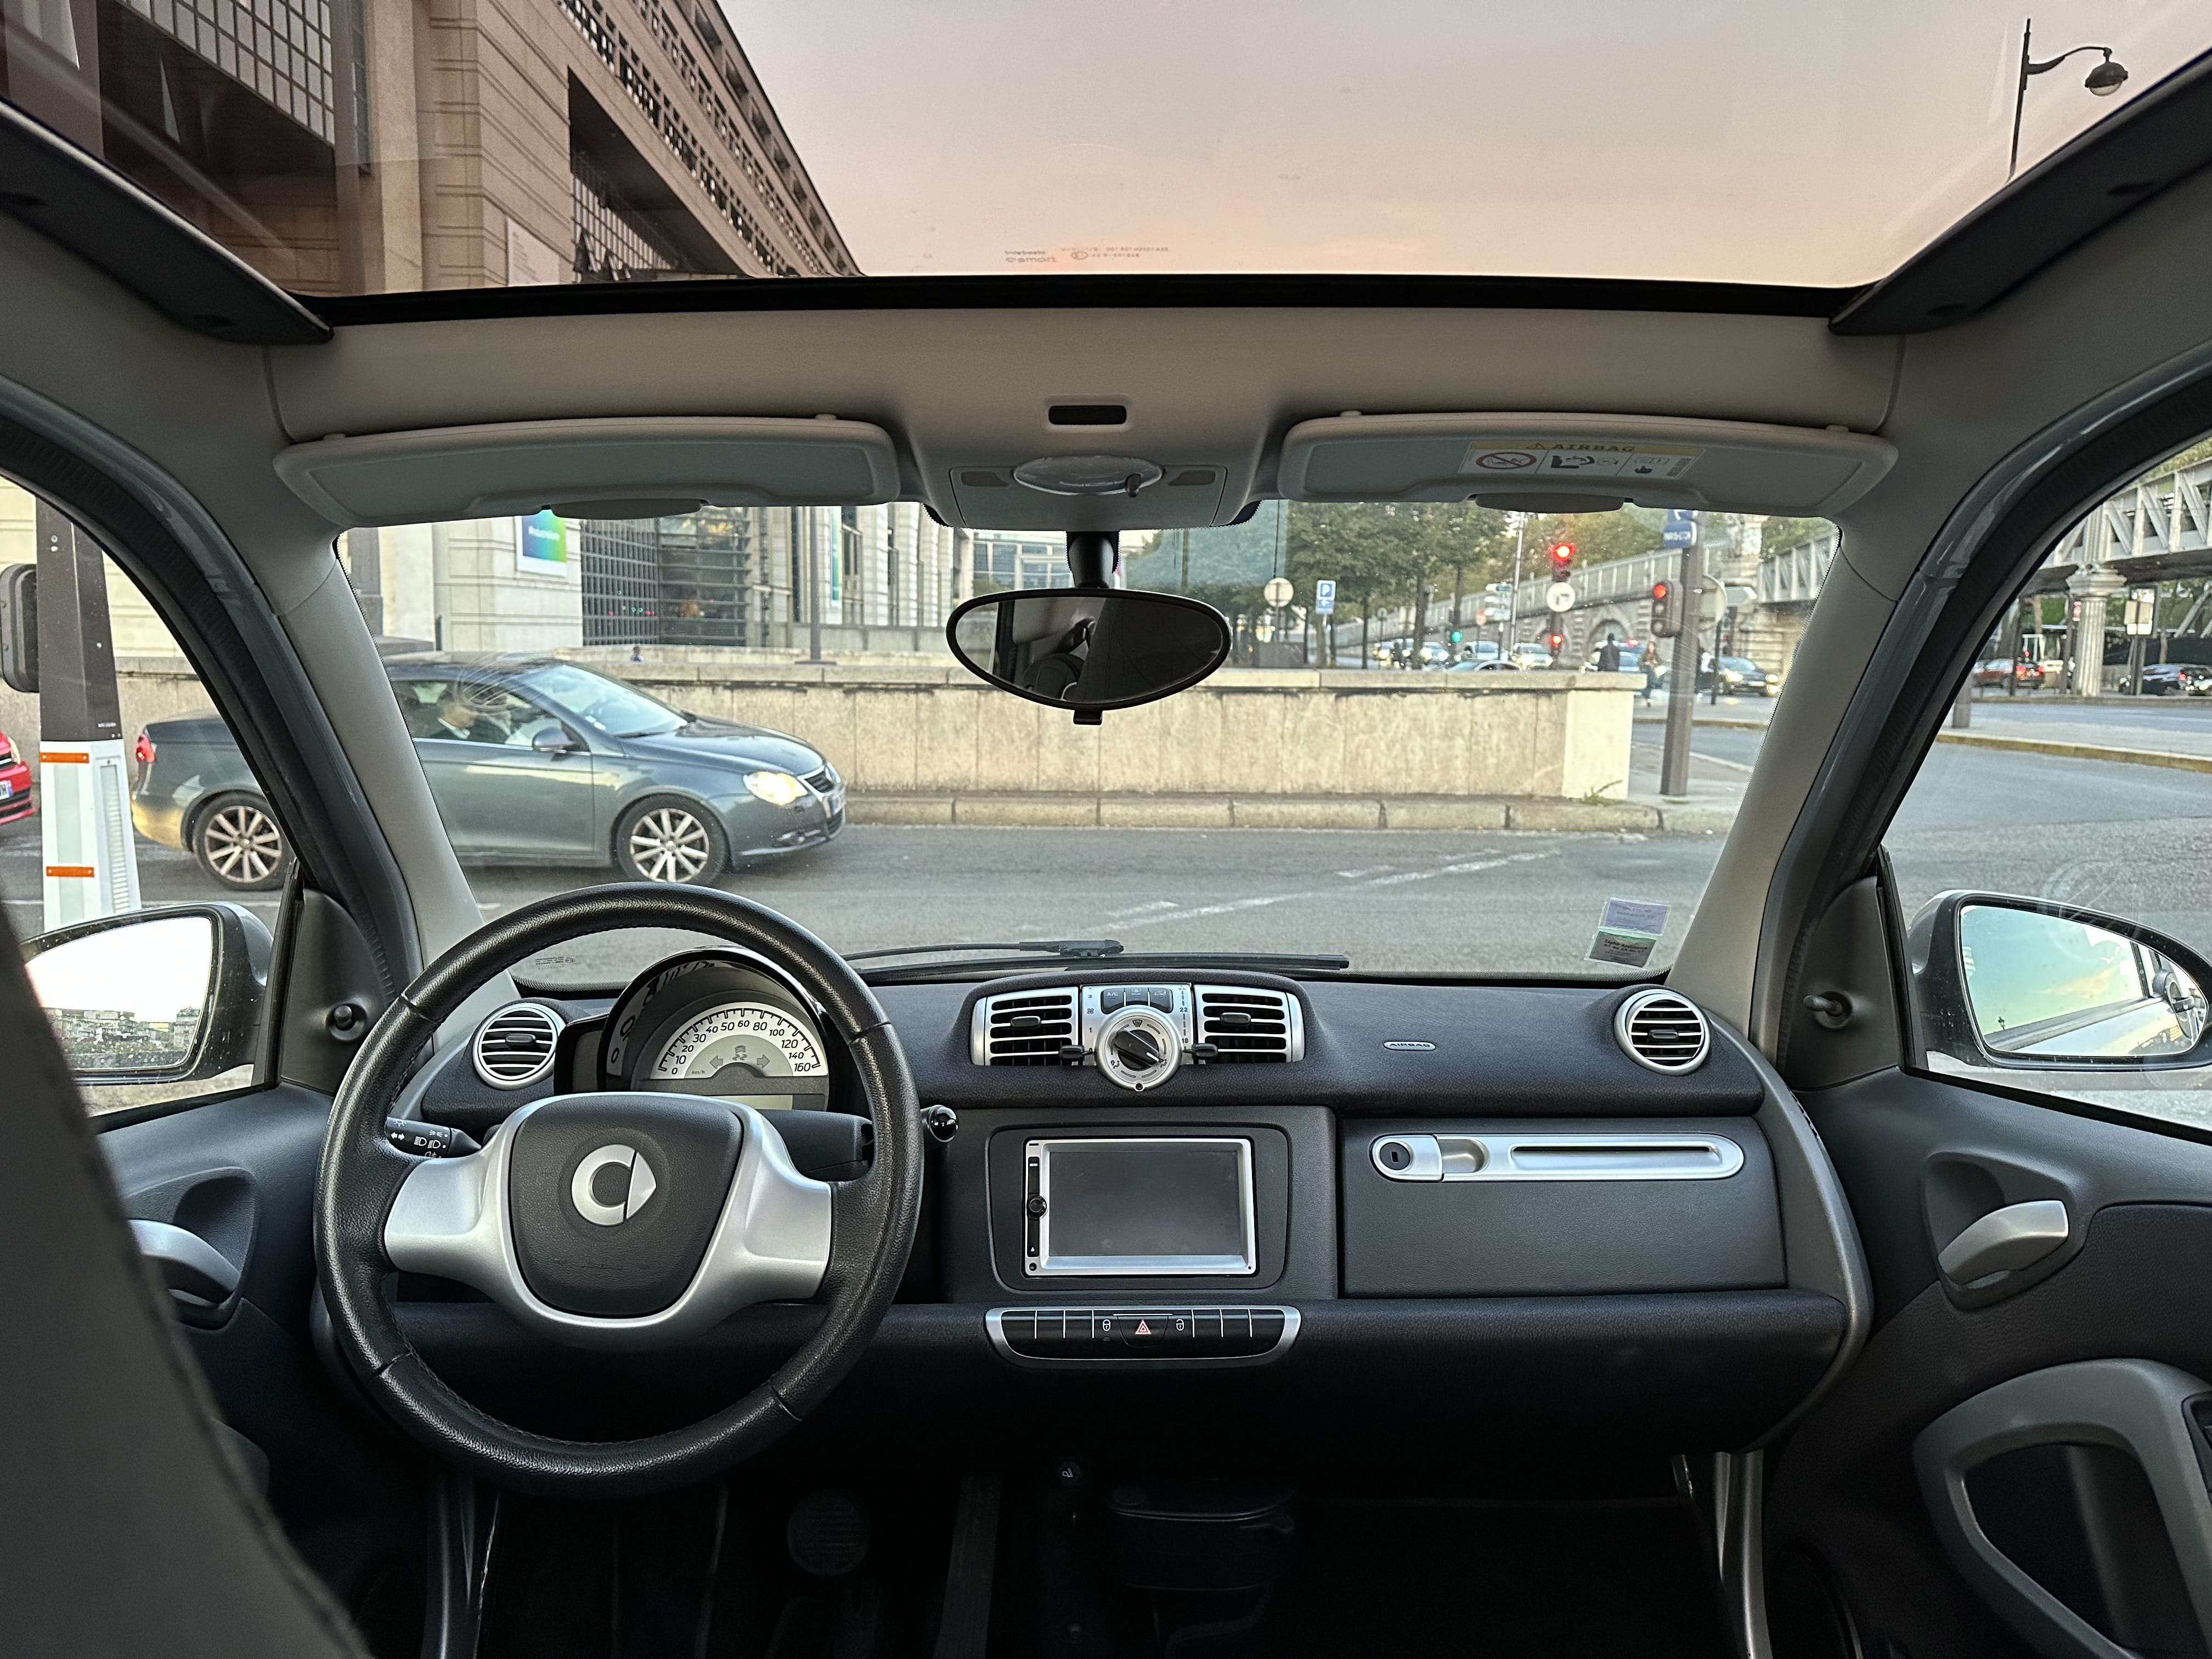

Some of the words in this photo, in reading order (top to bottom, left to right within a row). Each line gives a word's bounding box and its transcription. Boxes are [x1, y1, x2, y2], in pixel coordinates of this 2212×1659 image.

[1552, 444, 1635, 452] AIRBAG
[720, 1022, 735, 1031] 50
[752, 1022, 768, 1031] 80
[692, 1034, 707, 1042] 30
[781, 1039, 799, 1048] 120
[675, 1055, 686, 1064] 10
[794, 1063, 811, 1072] 160
